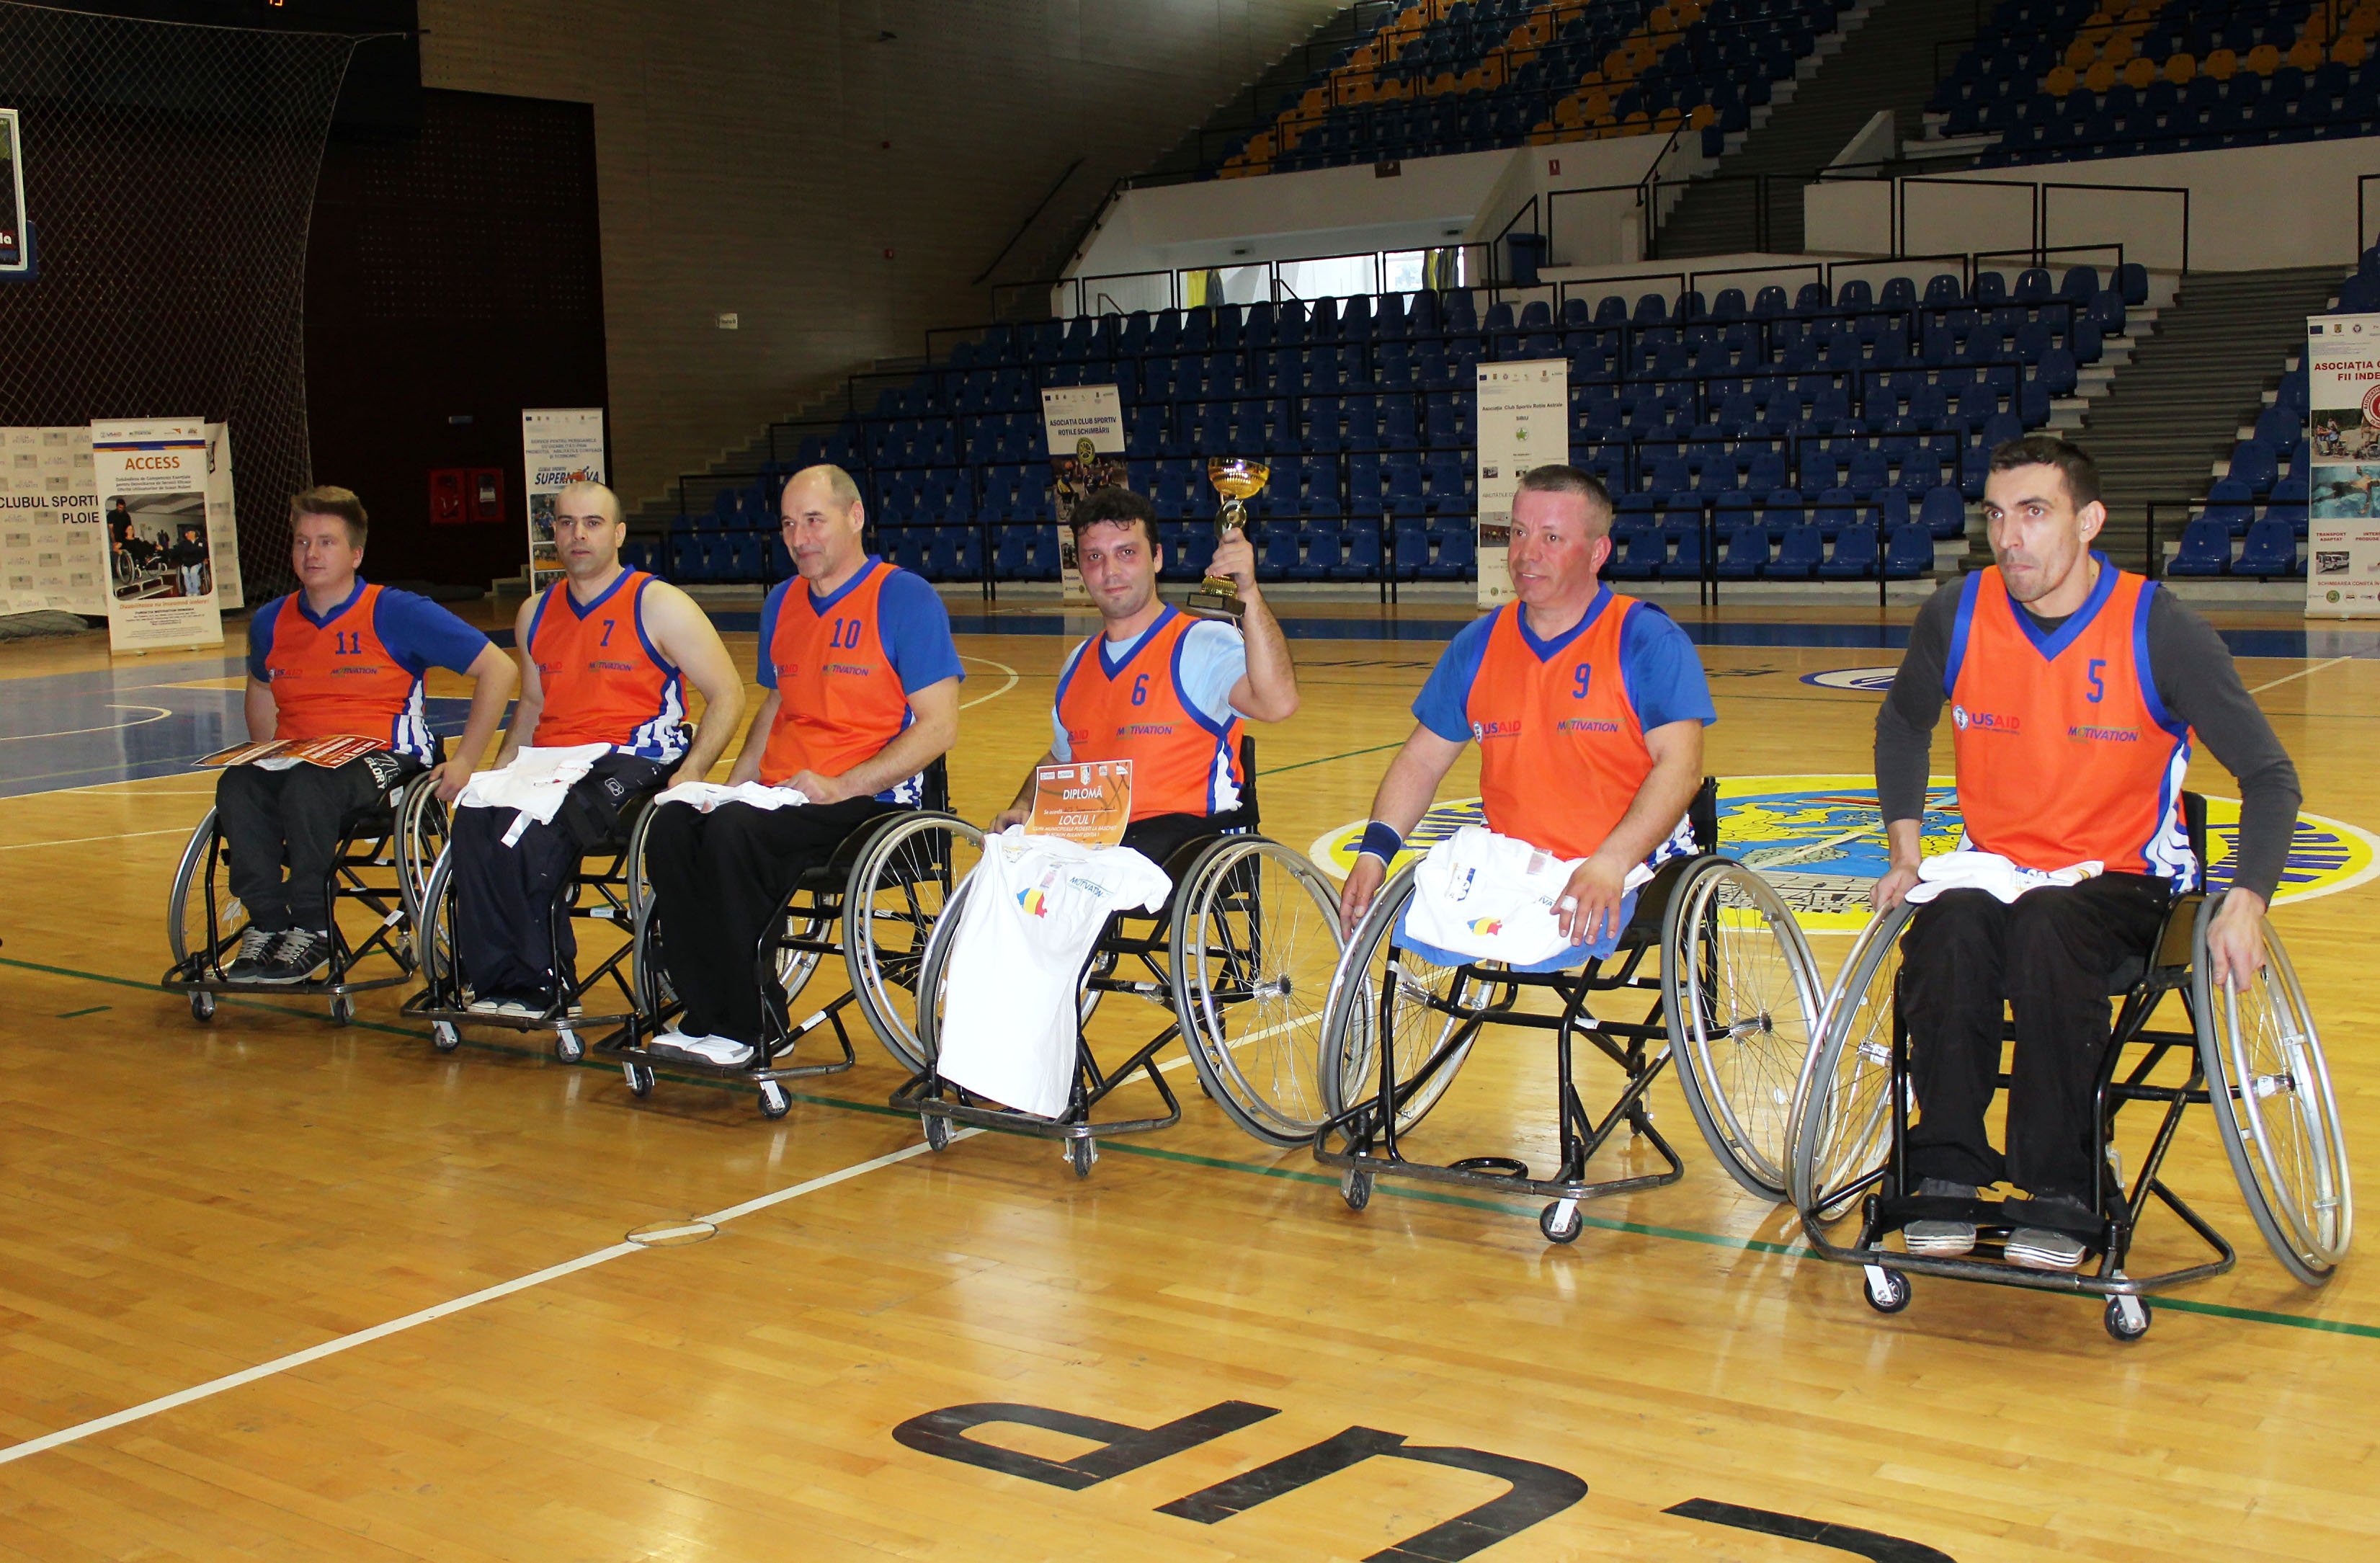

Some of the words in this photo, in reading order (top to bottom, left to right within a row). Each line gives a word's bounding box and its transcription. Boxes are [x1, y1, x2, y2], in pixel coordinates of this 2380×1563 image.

[125, 456, 180, 470] ACCESS
[52, 495, 99, 507] SPORTI
[62, 512, 99, 524] PLOIE
[600, 620, 615, 646] 7
[829, 618, 861, 649] 10
[335, 631, 362, 654] 11
[1572, 663, 1591, 698] 9
[2086, 659, 2106, 703] 5
[1131, 674, 1149, 705] 6
[1483, 721, 1522, 734] USAID
[1556, 720, 1618, 732] MOTIVATION
[1971, 712, 2020, 729] USAID
[1116, 725, 1172, 736] MOTIVATION
[2067, 726, 2139, 742] MOTIVATION
[363, 756, 386, 790] GLORY
[1063, 785, 1103, 800] DIPLOMĂ
[1058, 814, 1089, 825] LOCUL
